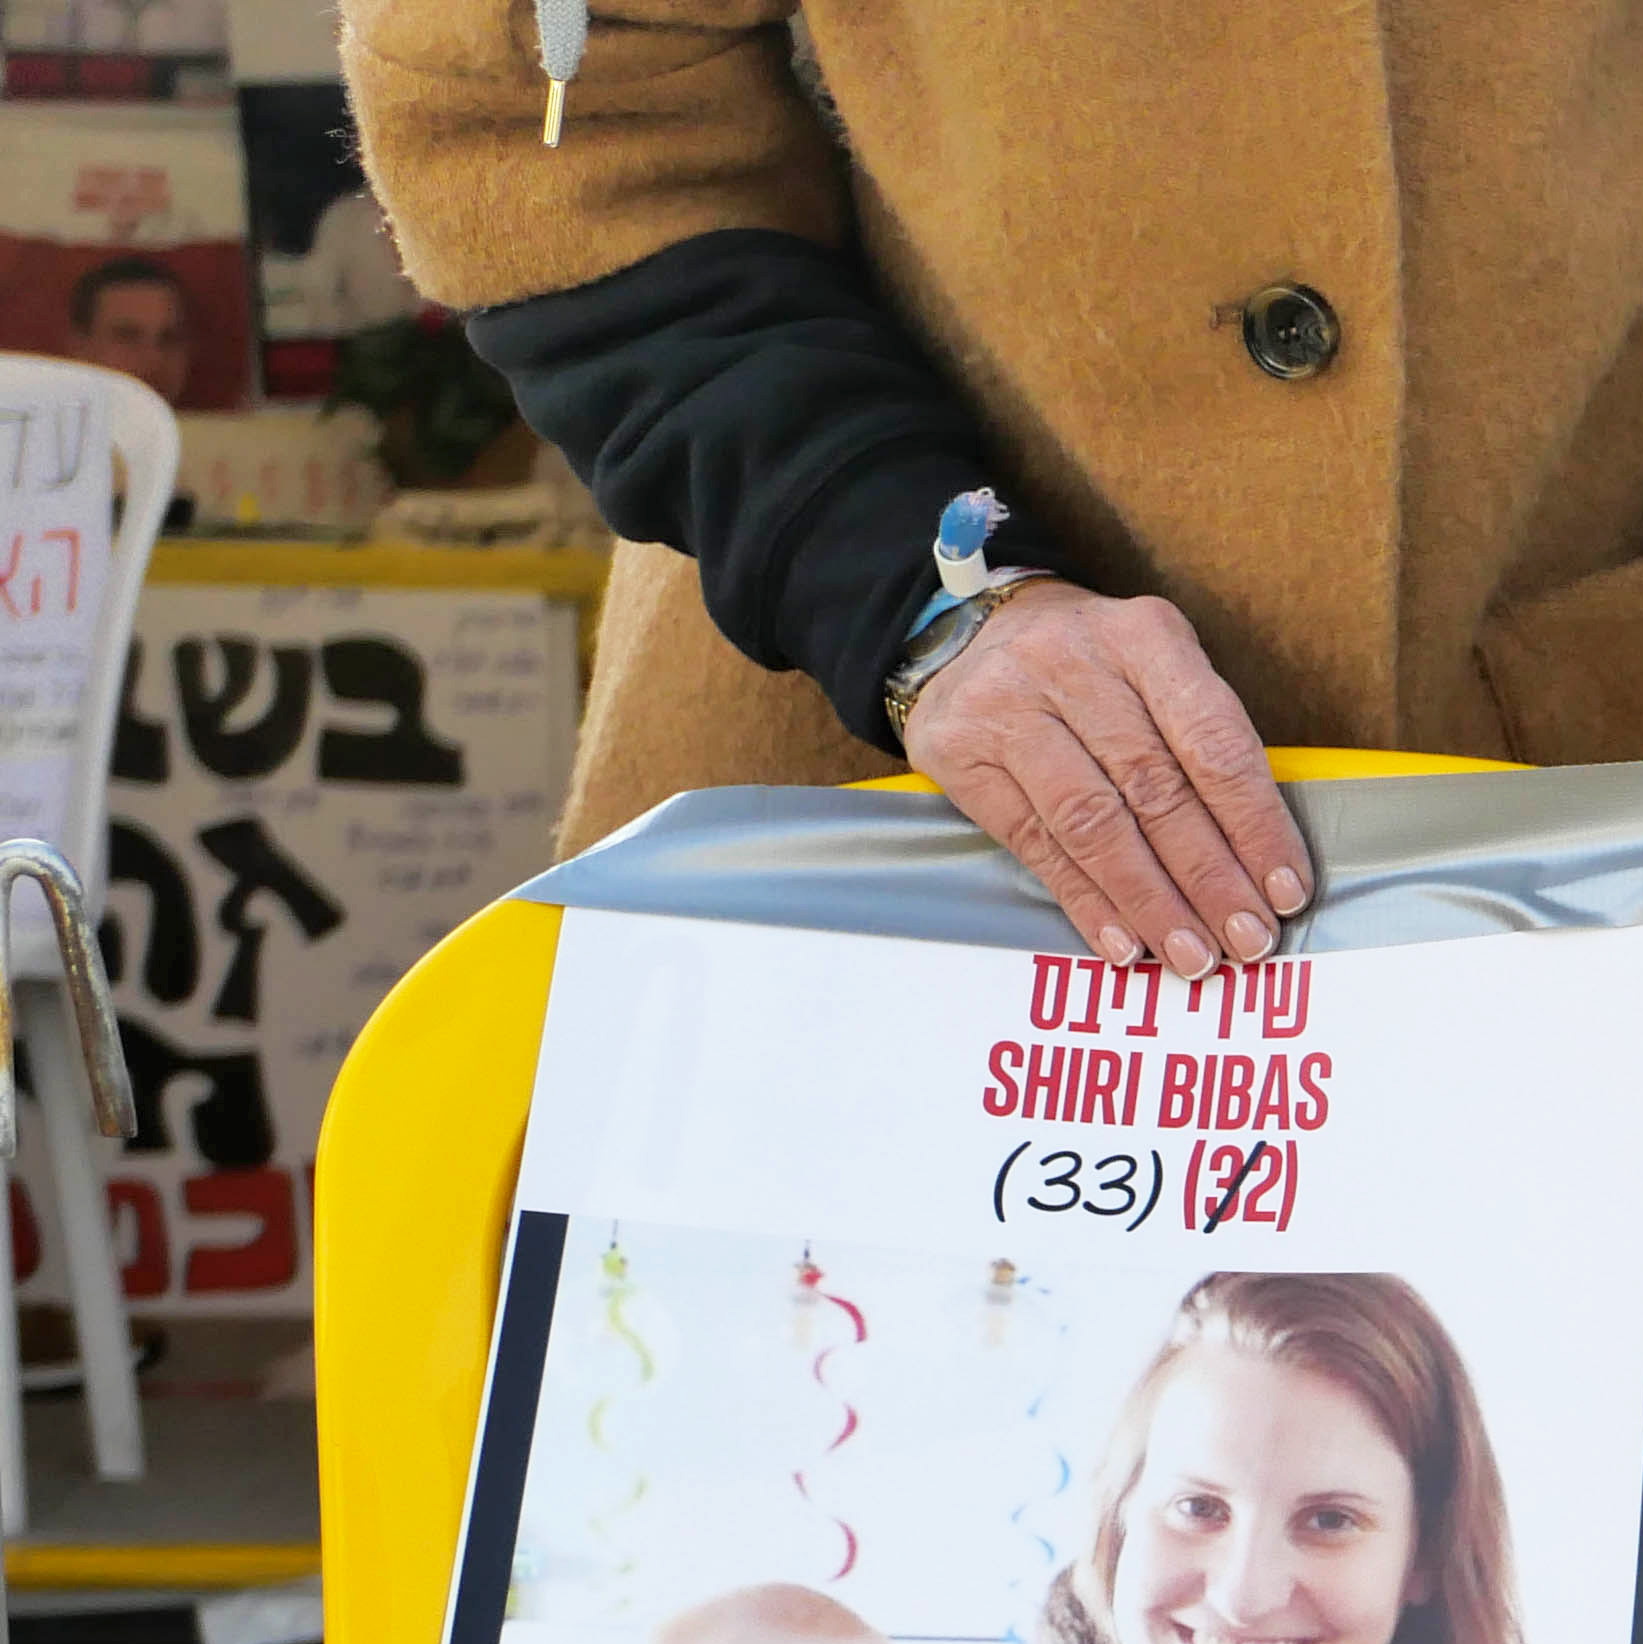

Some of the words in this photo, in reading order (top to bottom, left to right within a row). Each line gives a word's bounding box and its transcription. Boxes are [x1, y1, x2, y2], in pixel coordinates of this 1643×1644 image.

[1029, 953, 1163, 1038] ביבס
[982, 1040, 1144, 1127] SHIRI
[1157, 1051, 1333, 1131] BIBAS
[992, 1140, 1164, 1233] (33)
